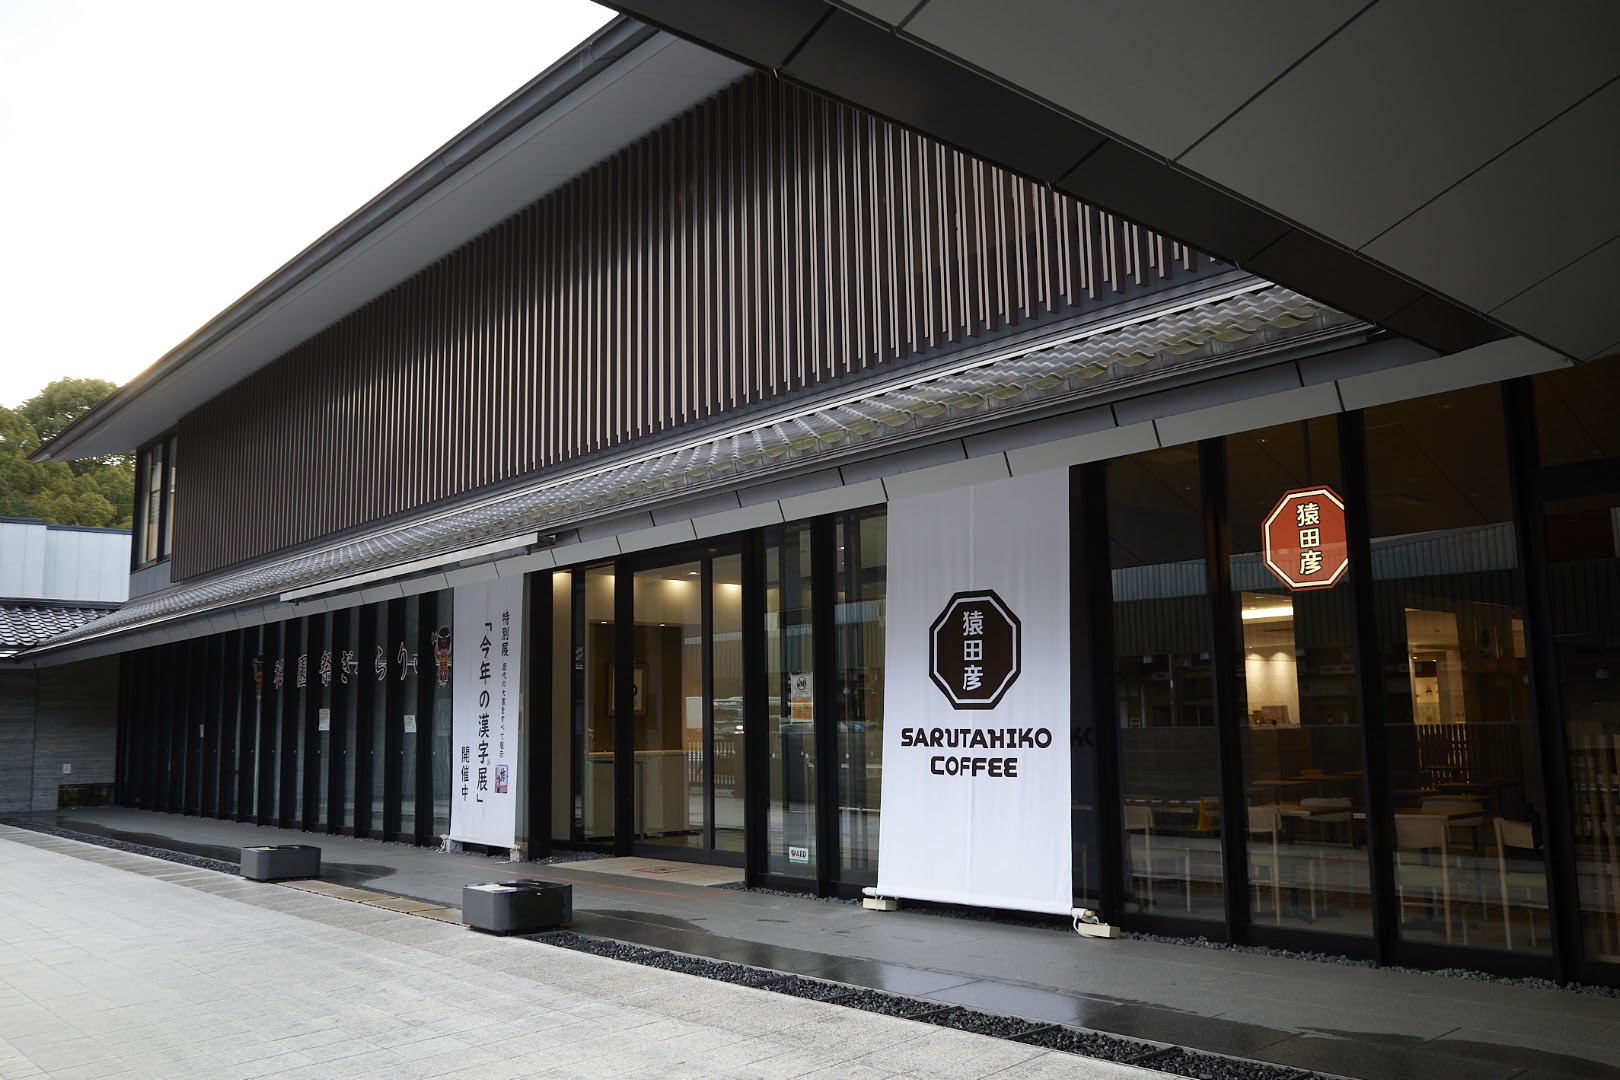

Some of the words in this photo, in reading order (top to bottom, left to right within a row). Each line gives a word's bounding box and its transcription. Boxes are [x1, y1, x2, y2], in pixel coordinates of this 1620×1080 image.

[1296, 502, 1323, 575] 猿田彦
[501, 610, 511, 657] 特別展
[962, 610, 984, 691] 猿田彦
[901, 727, 1053, 749] SARUTAHIKO
[460, 746, 470, 802] 開催中
[930, 755, 1018, 778] COFFEE
[795, 850, 807, 858] AED
